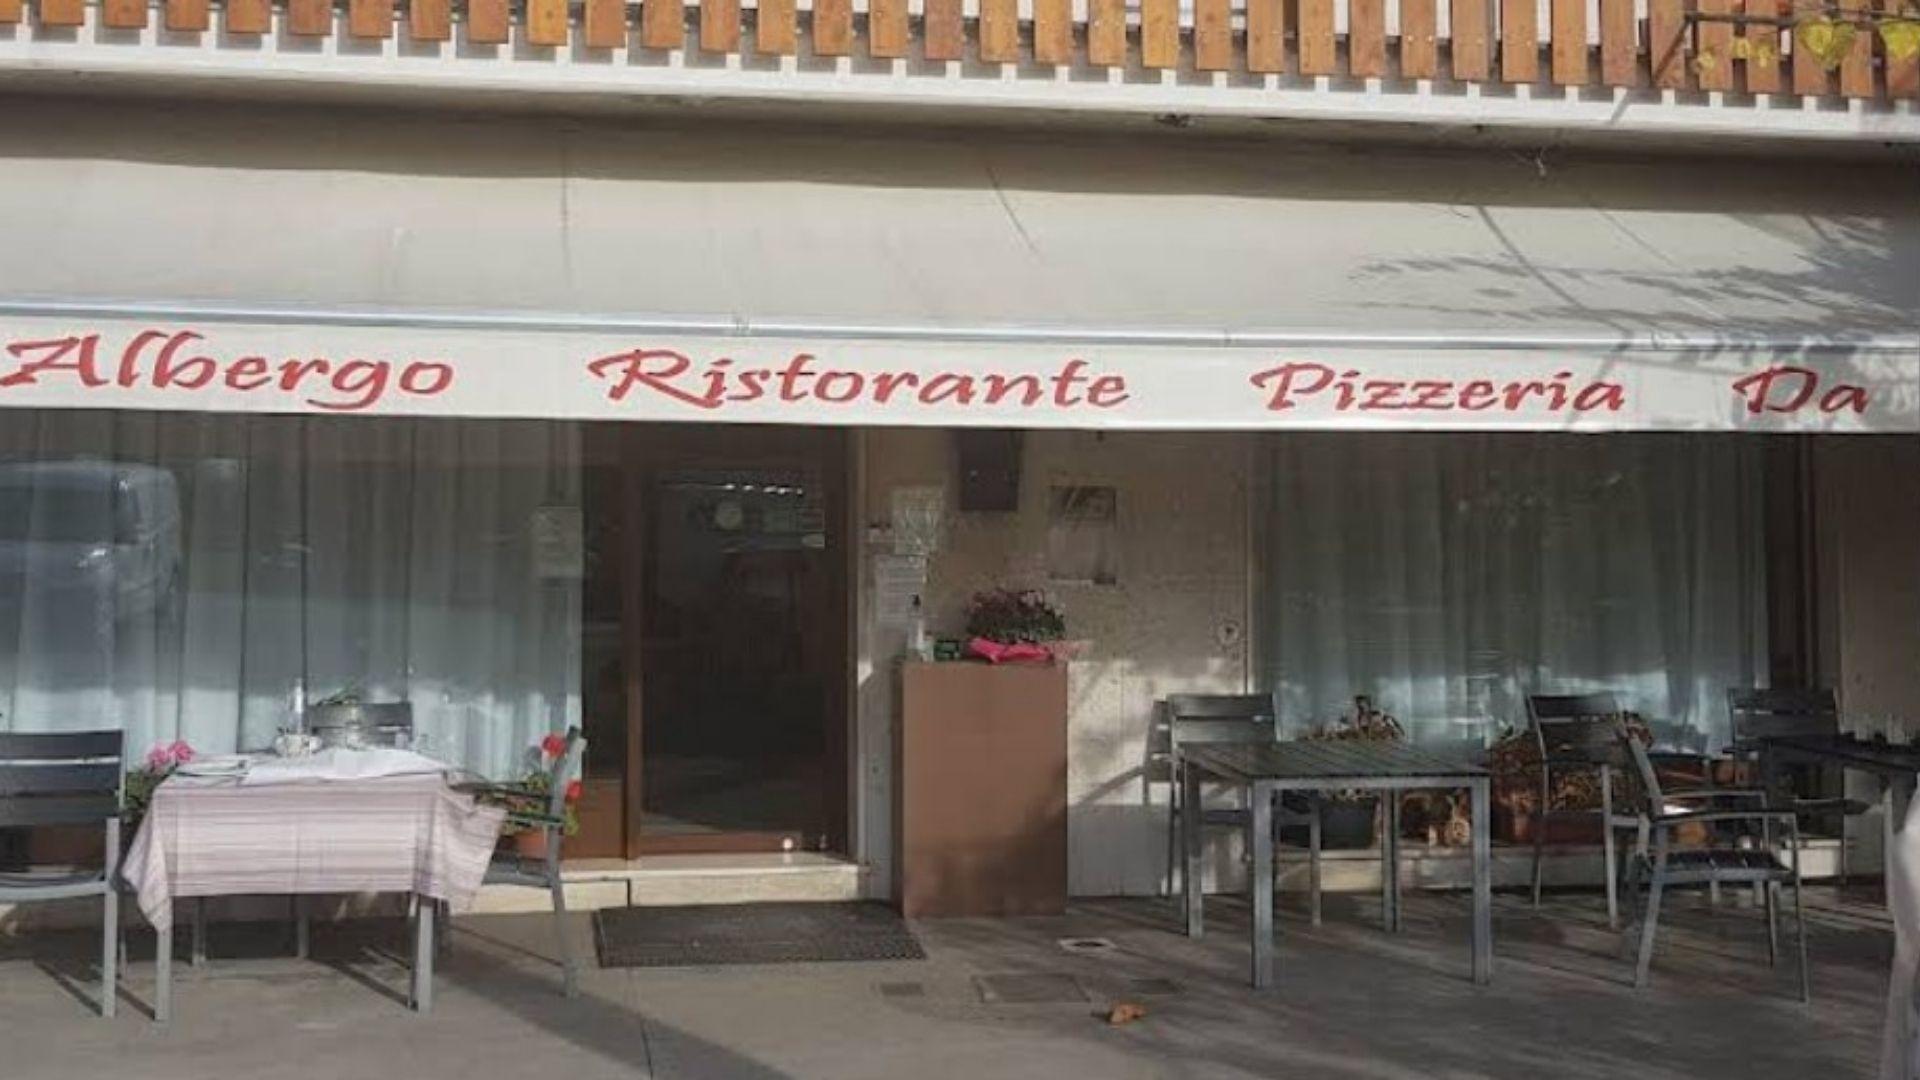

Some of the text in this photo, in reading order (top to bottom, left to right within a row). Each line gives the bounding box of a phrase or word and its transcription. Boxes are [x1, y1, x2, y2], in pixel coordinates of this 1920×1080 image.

[0, 330, 1868, 415] Albergo Ristorante Pizzeria Da
